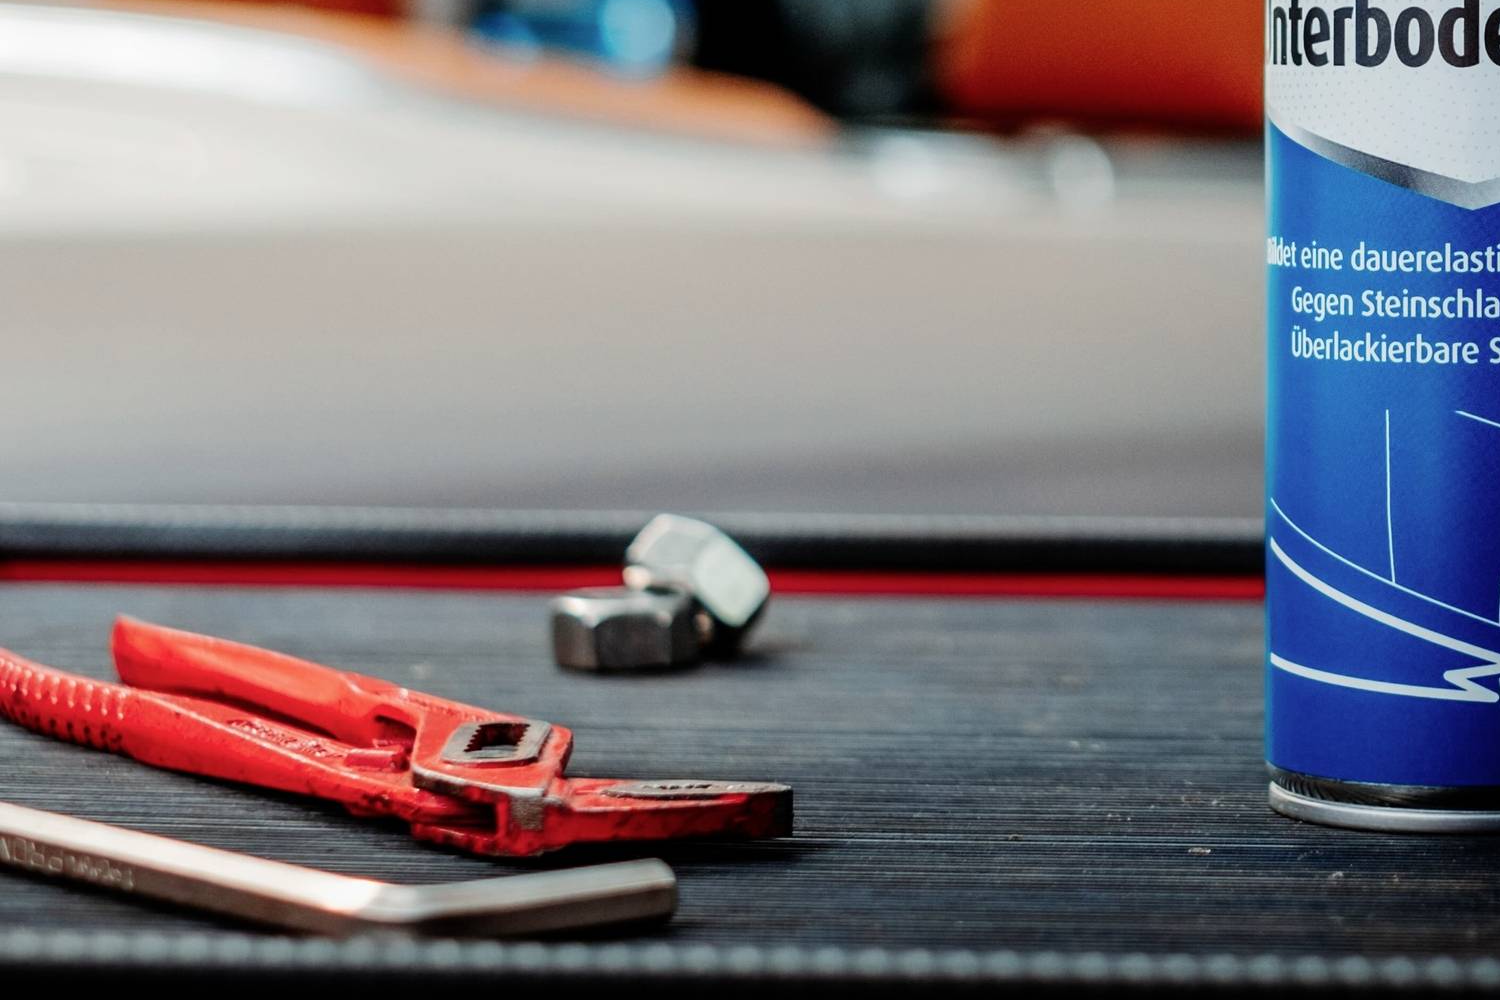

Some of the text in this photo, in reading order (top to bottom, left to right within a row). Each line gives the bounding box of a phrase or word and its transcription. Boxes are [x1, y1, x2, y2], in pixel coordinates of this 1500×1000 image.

[1300, 240, 1344, 271] eine
[1291, 286, 1354, 322] Gegen
[1291, 325, 1480, 364] Überlackierbare
